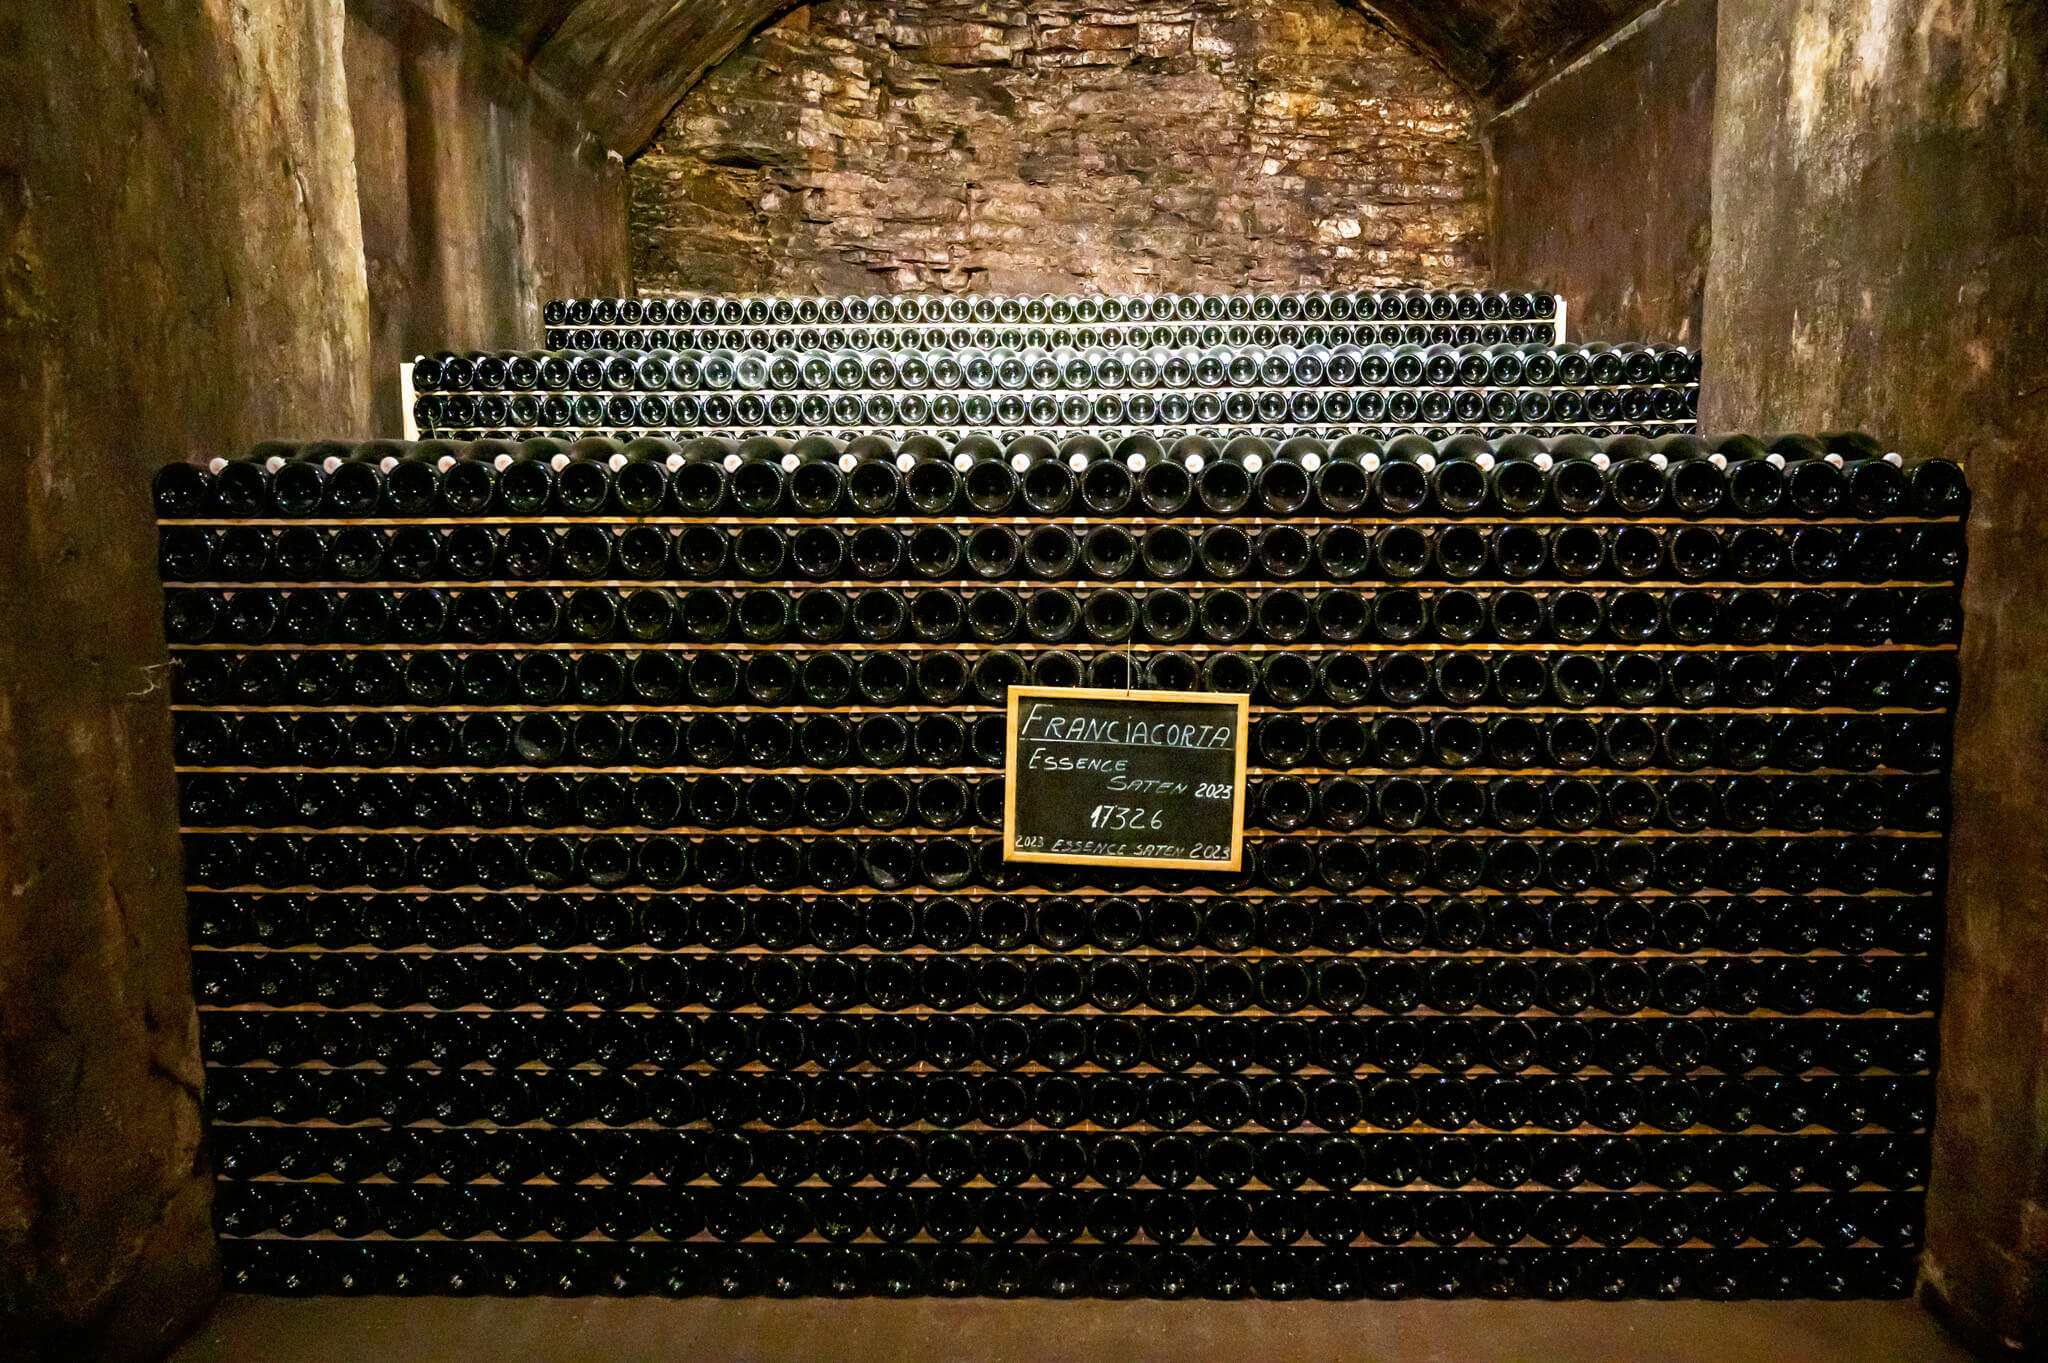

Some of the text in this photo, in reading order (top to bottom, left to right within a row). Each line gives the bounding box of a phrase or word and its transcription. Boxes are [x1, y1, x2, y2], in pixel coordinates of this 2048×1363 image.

[1028, 747, 1129, 771] ESSENCE
[1106, 775, 1233, 799] SATEN 2023
[1090, 804, 1164, 830] 17326
[1015, 835, 1045, 848] 2023
[1051, 839, 1127, 856] ESSENCE
[1189, 843, 1231, 860] 2023
